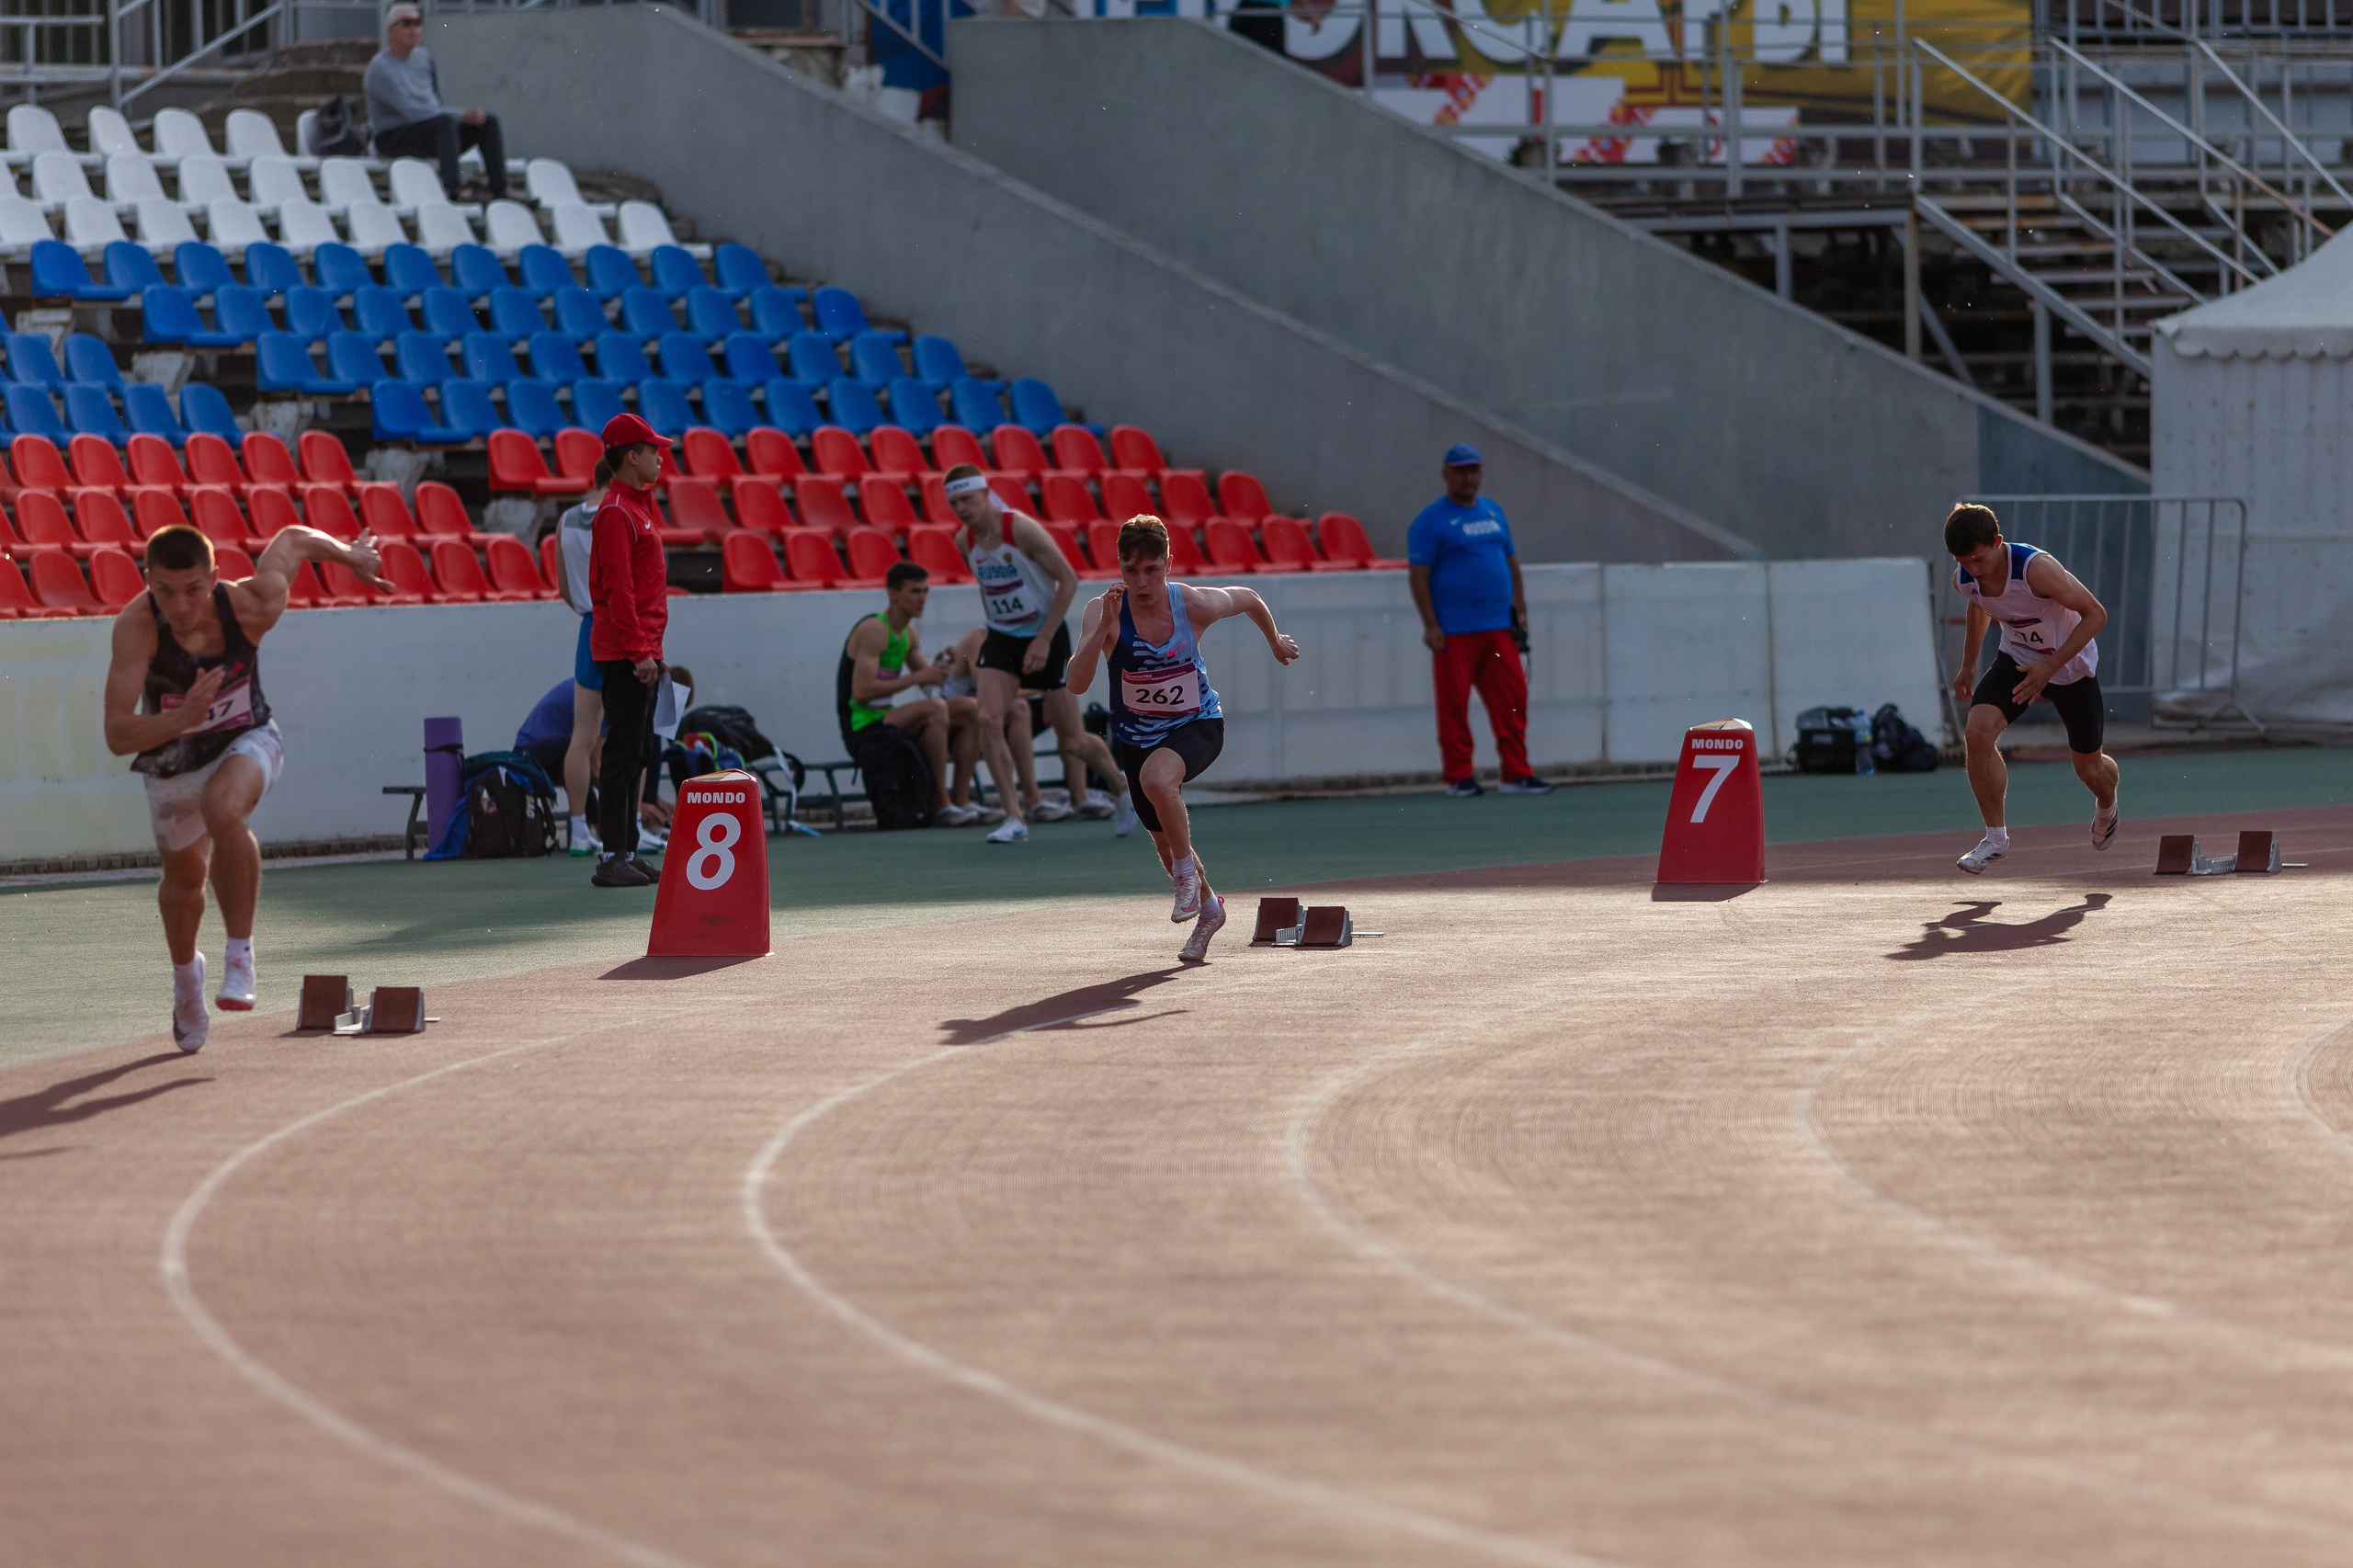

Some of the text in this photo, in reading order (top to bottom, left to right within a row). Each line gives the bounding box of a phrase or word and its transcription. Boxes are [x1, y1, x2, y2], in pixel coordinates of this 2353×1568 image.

[977, 563, 1018, 580] RUSSIA
[992, 596, 1024, 615] 114
[1134, 685, 1185, 706] 262
[1691, 738, 1744, 750] MONDO
[687, 791, 746, 804] MONDO
[1689, 755, 1741, 824] 7
[686, 812, 741, 891] 8
